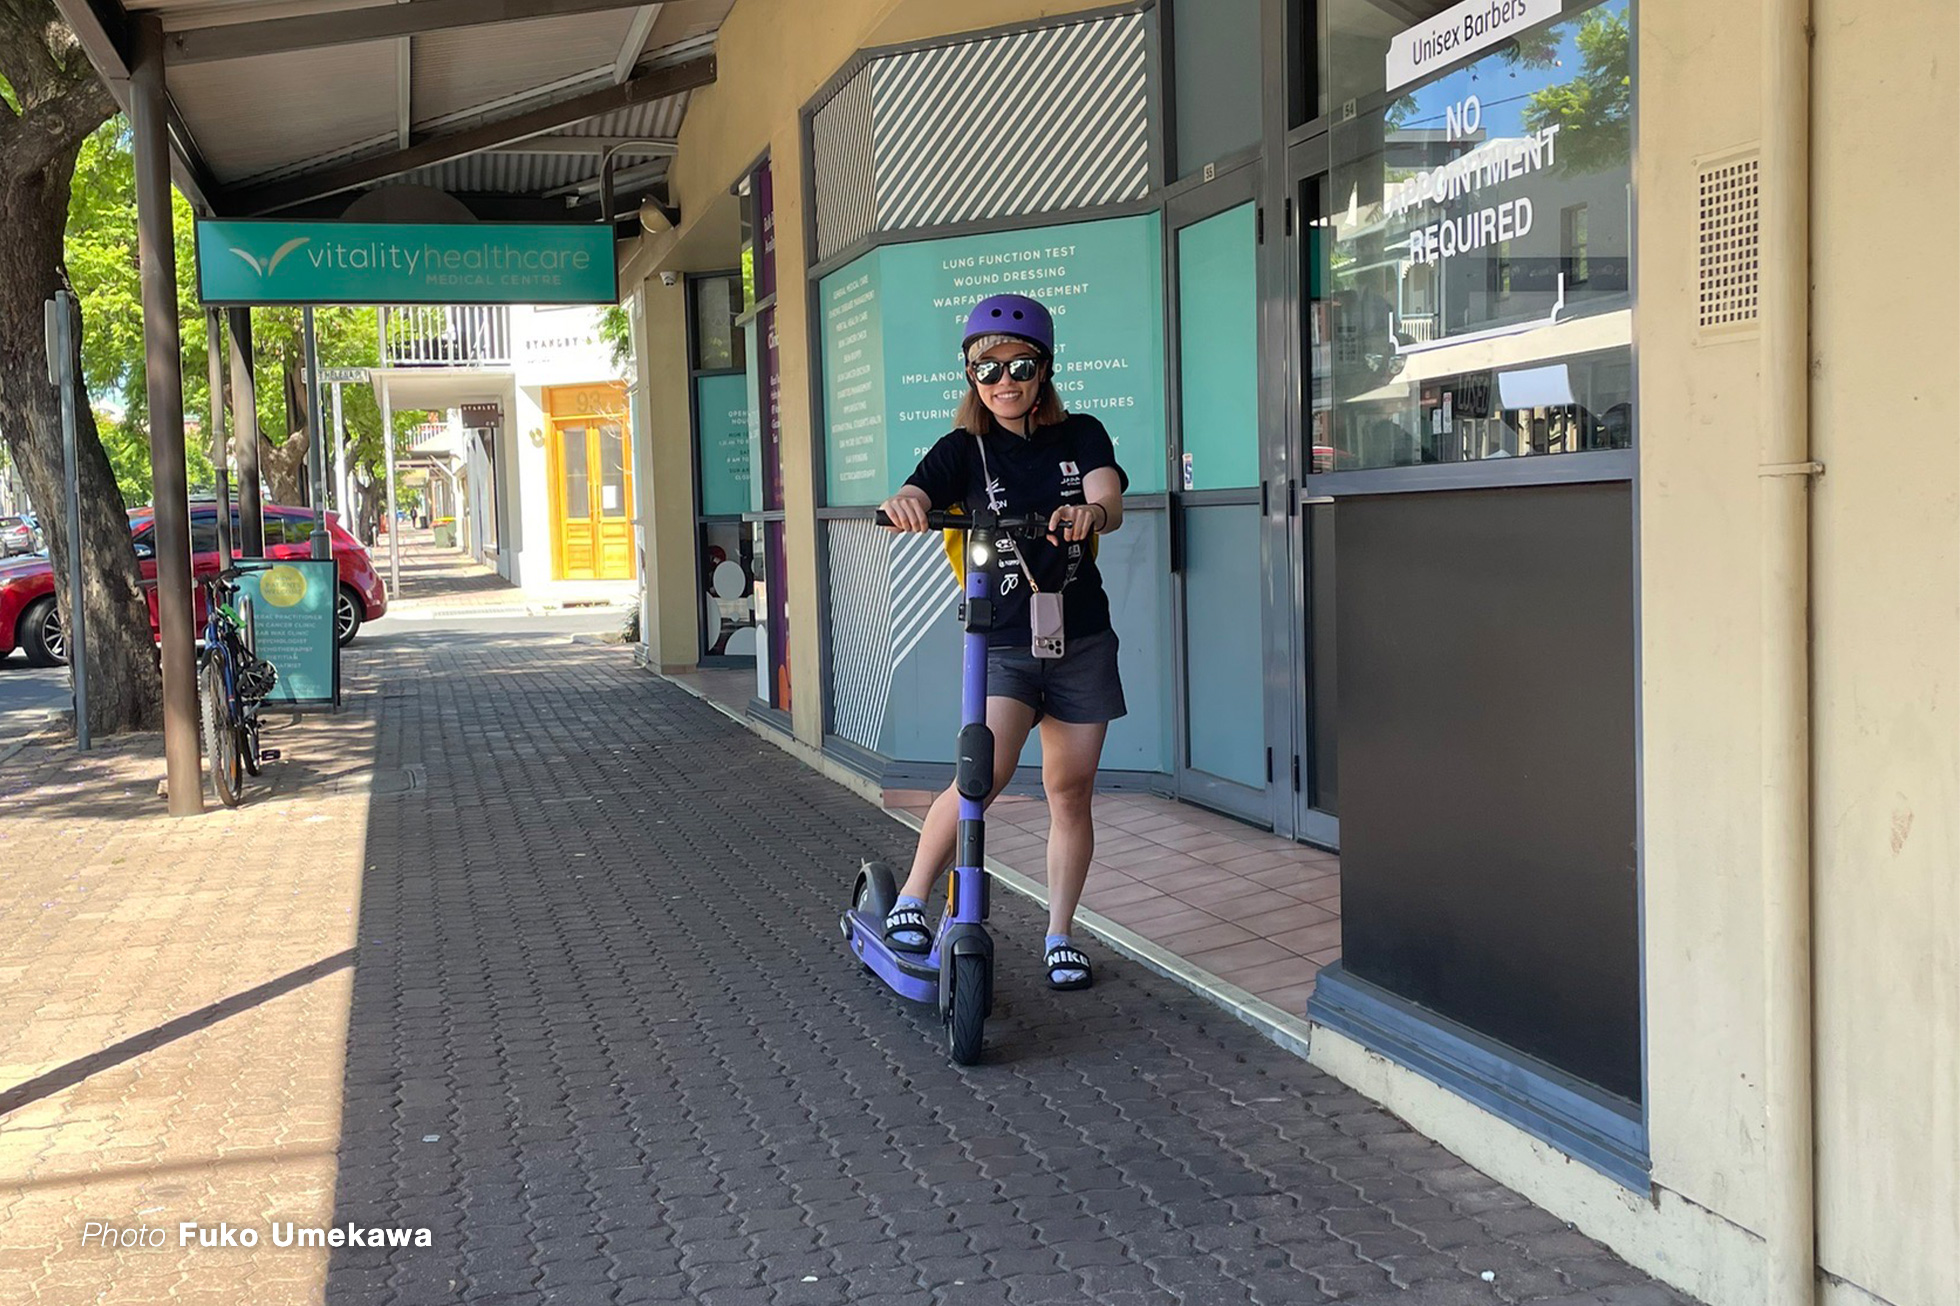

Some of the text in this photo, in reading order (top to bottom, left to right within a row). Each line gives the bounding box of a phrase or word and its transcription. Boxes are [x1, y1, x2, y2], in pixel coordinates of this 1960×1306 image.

[1412, 0, 1526, 65] Unisex Barbers
[1446, 94, 1480, 142] NO
[1386, 124, 1560, 215] APPOINTMENT
[1410, 197, 1533, 265] REQUIRED
[943, 246, 1076, 270] LUNG FUNCTION TEST
[426, 274, 562, 285] MEDICAL CENTRE
[954, 266, 1066, 287] WOUND DRESSING
[902, 371, 963, 384] IMPLANON
[1067, 358, 1128, 372] REMOVAL
[1075, 396, 1134, 410] SUTURES
